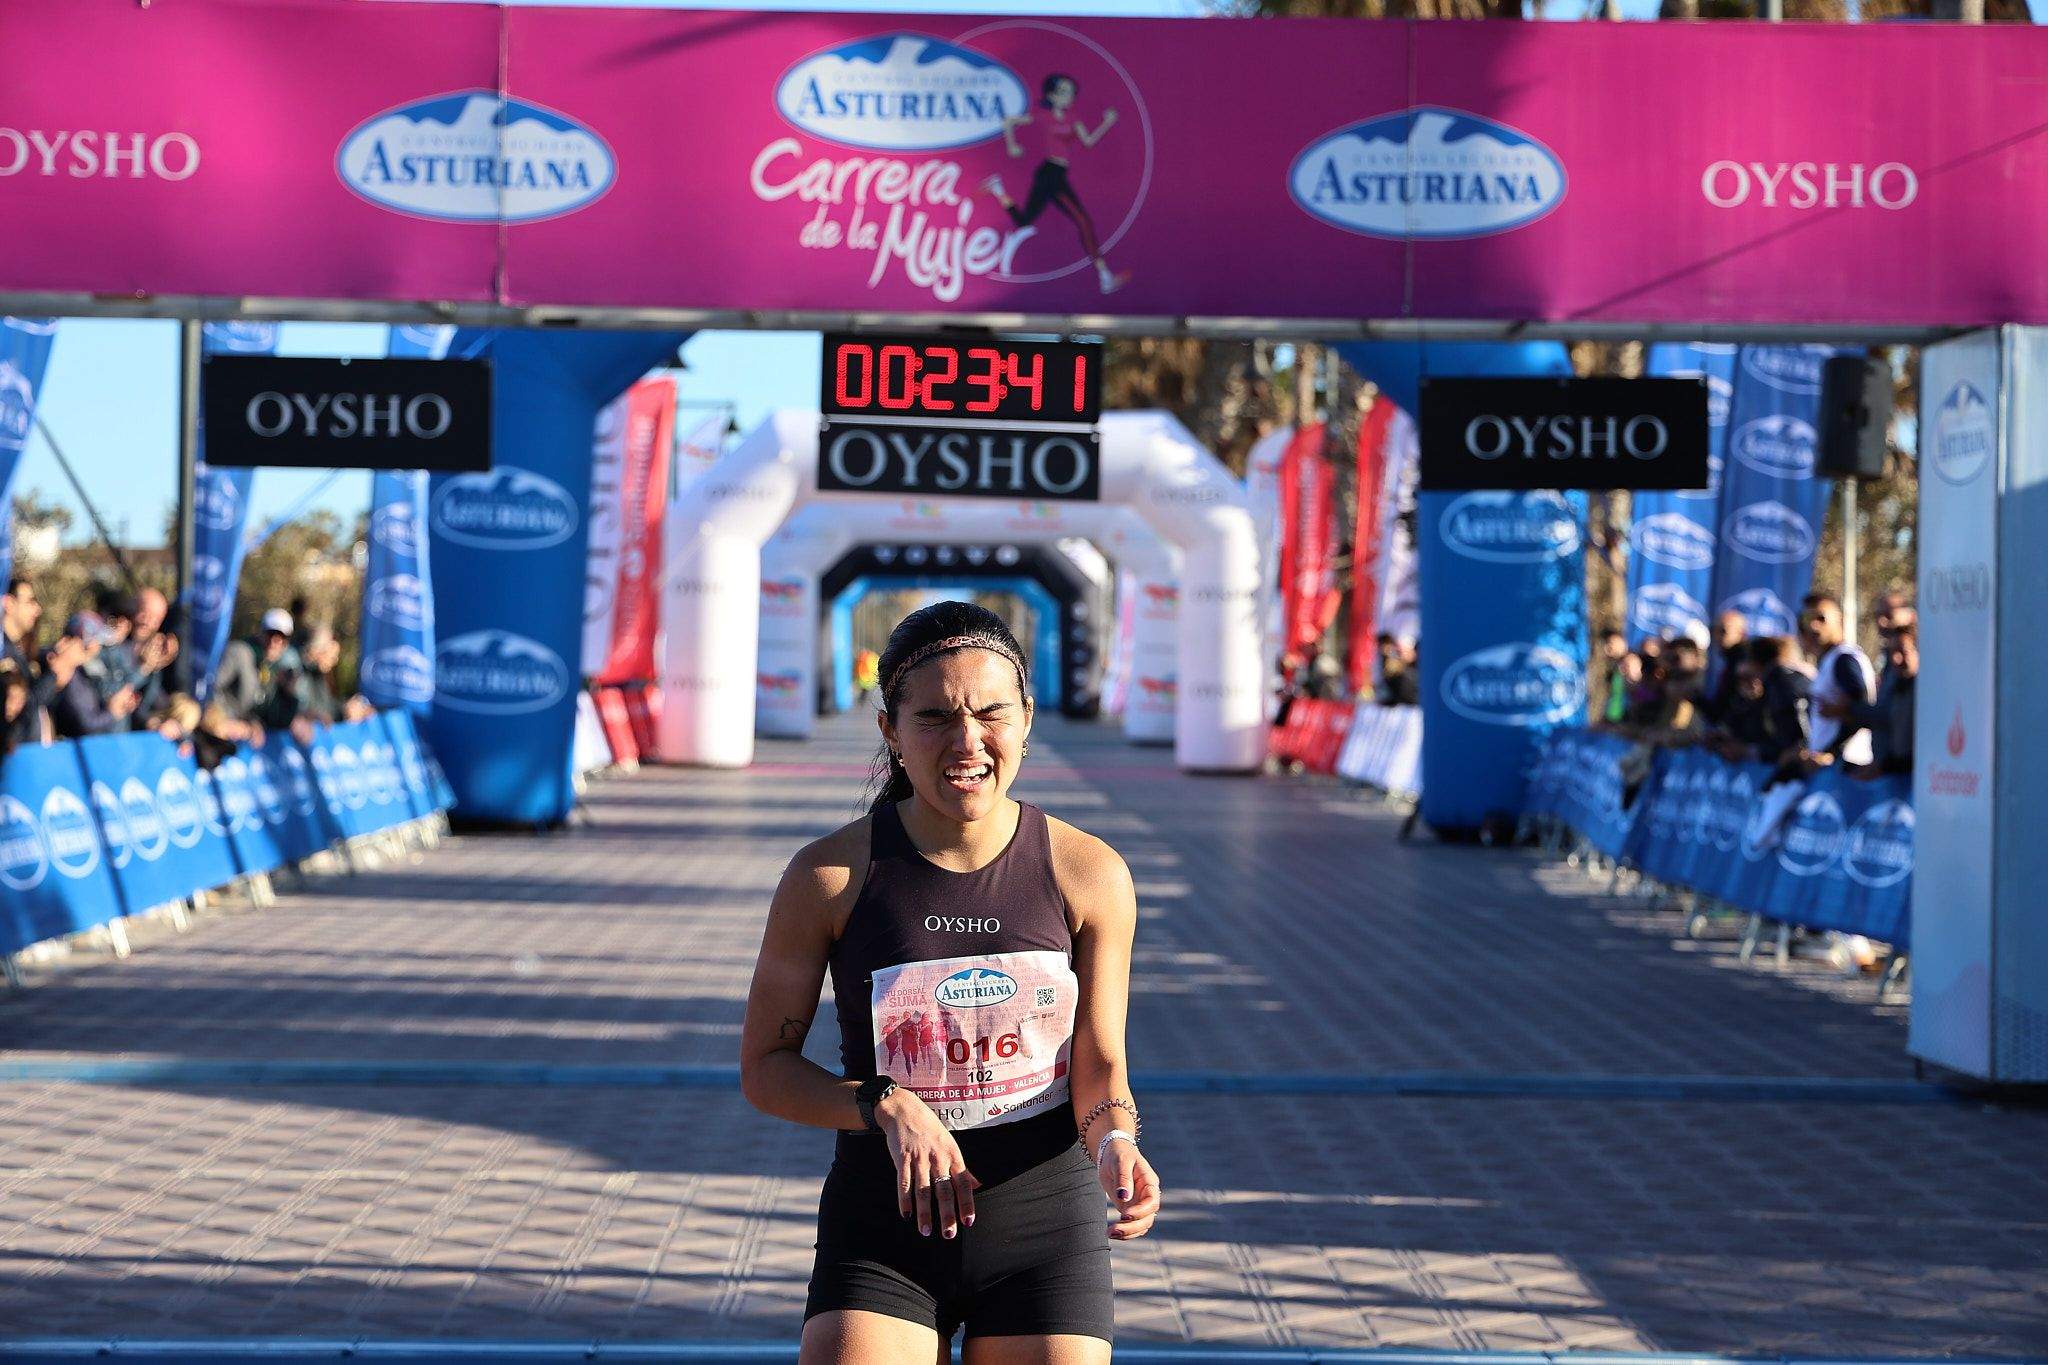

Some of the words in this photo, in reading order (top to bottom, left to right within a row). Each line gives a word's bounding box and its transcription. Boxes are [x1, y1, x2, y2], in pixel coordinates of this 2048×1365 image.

[797, 75, 1008, 122] ASTURIANA
[362, 139, 592, 190] ASTURIANA
[750, 137, 963, 206] Carrera
[1314, 154, 1542, 204] ASTURIANA
[1701, 159, 1918, 210] OYSHO
[800, 203, 842, 249] de
[847, 203, 880, 250] la
[866, 198, 1037, 302] Mujer
[246, 390, 452, 438] OYSHO
[1464, 413, 1669, 461] OYSHO
[828, 428, 1090, 494] OYSHO
[924, 916, 1001, 933] OYSHO
[941, 984, 1012, 1001] ASTURIANA
[946, 1033, 1019, 1065] 016
[948, 1089, 961, 1098] DE
[963, 1088, 975, 1098] LA
[976, 1084, 1007, 1097] MUJER
[1014, 1071, 1051, 1089] VALENCIA
[967, 1070, 993, 1083] 102
[1003, 1092, 1054, 1114] Santander
